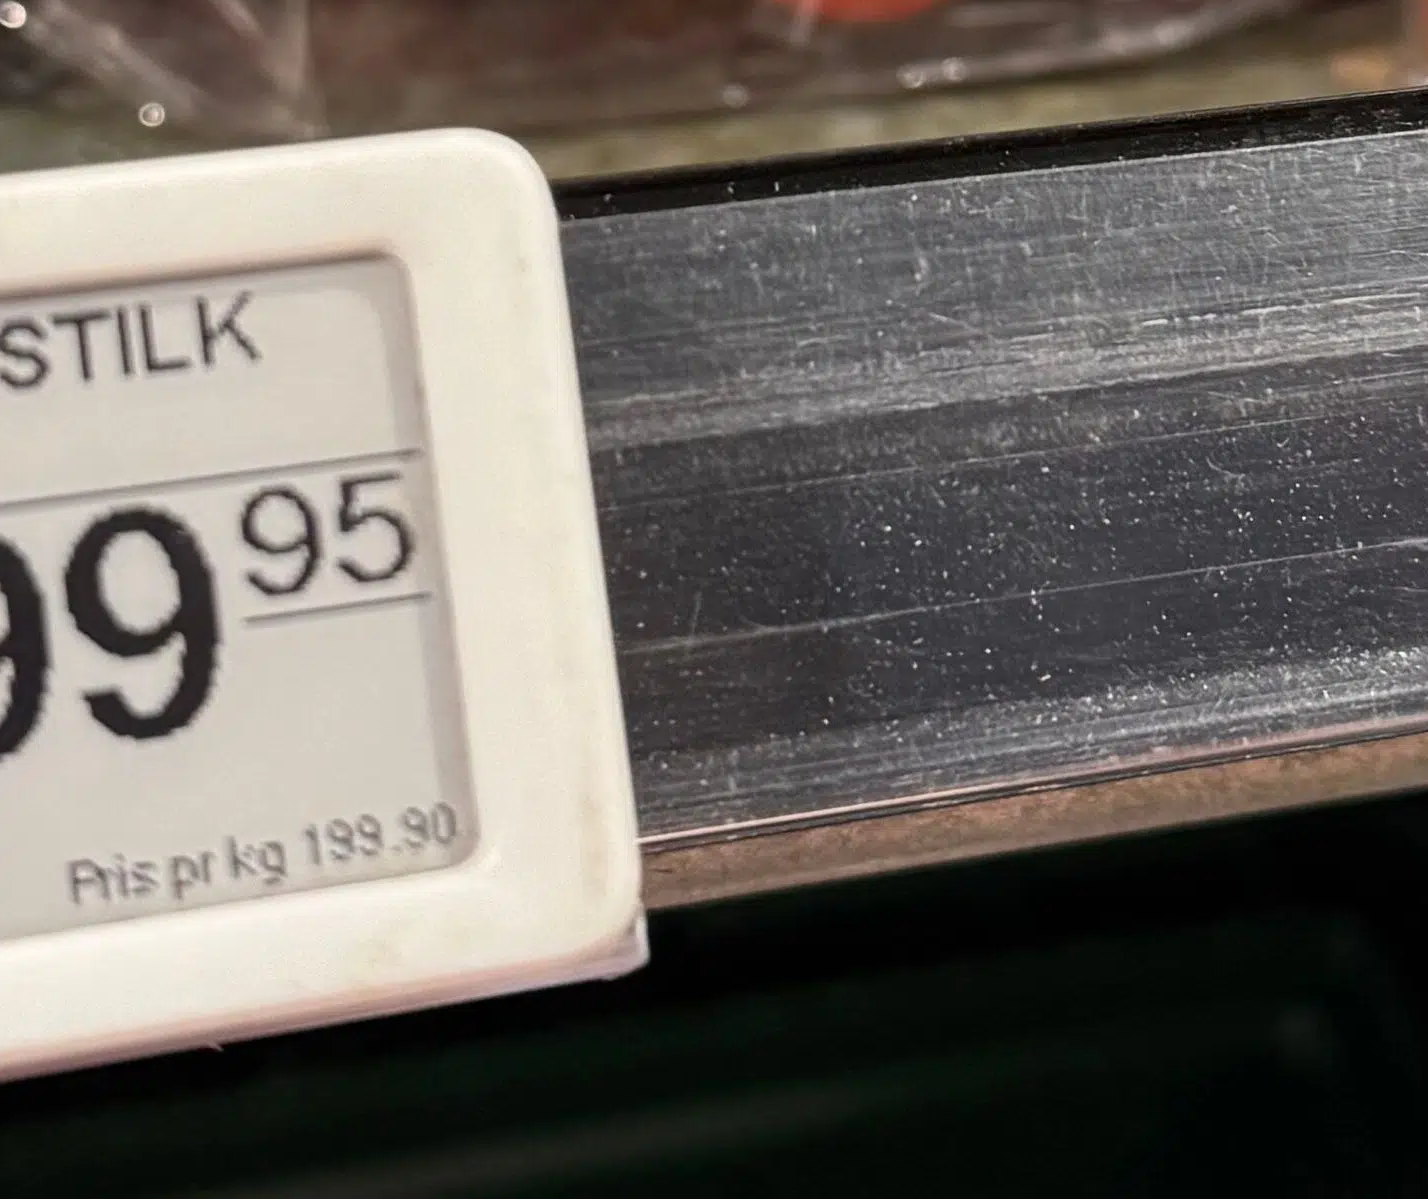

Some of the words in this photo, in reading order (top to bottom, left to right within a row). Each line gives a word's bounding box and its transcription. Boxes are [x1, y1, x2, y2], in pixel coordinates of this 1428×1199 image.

[240, 470, 416, 596] 95
[69, 853, 158, 904] Pris
[170, 848, 217, 900] pr
[224, 834, 286, 884] kg
[299, 800, 458, 868] 199.90
